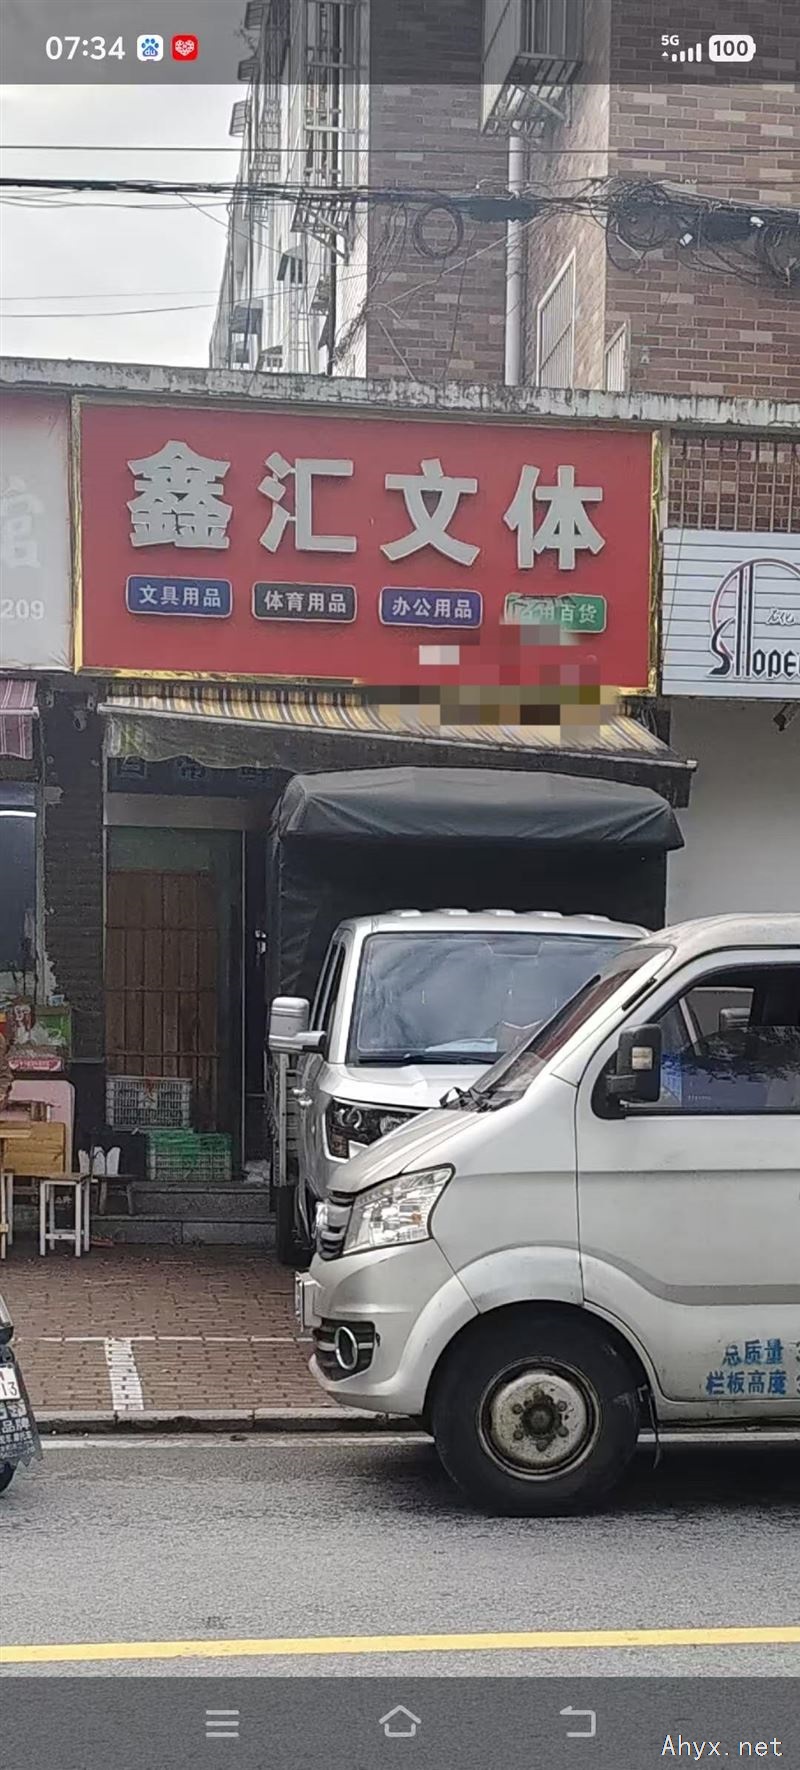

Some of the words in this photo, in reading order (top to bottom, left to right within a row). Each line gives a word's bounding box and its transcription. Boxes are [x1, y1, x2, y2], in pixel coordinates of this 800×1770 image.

[126, 440, 606, 571] 鑫汇文体
[139, 584, 222, 608] 文具用品
[264, 588, 347, 614] 体育用品
[391, 596, 473, 619] 办公用品
[0, 599, 45, 620] 209
[721, 1337, 785, 1367] 总质量
[705, 1369, 787, 1396] 栏板高度
